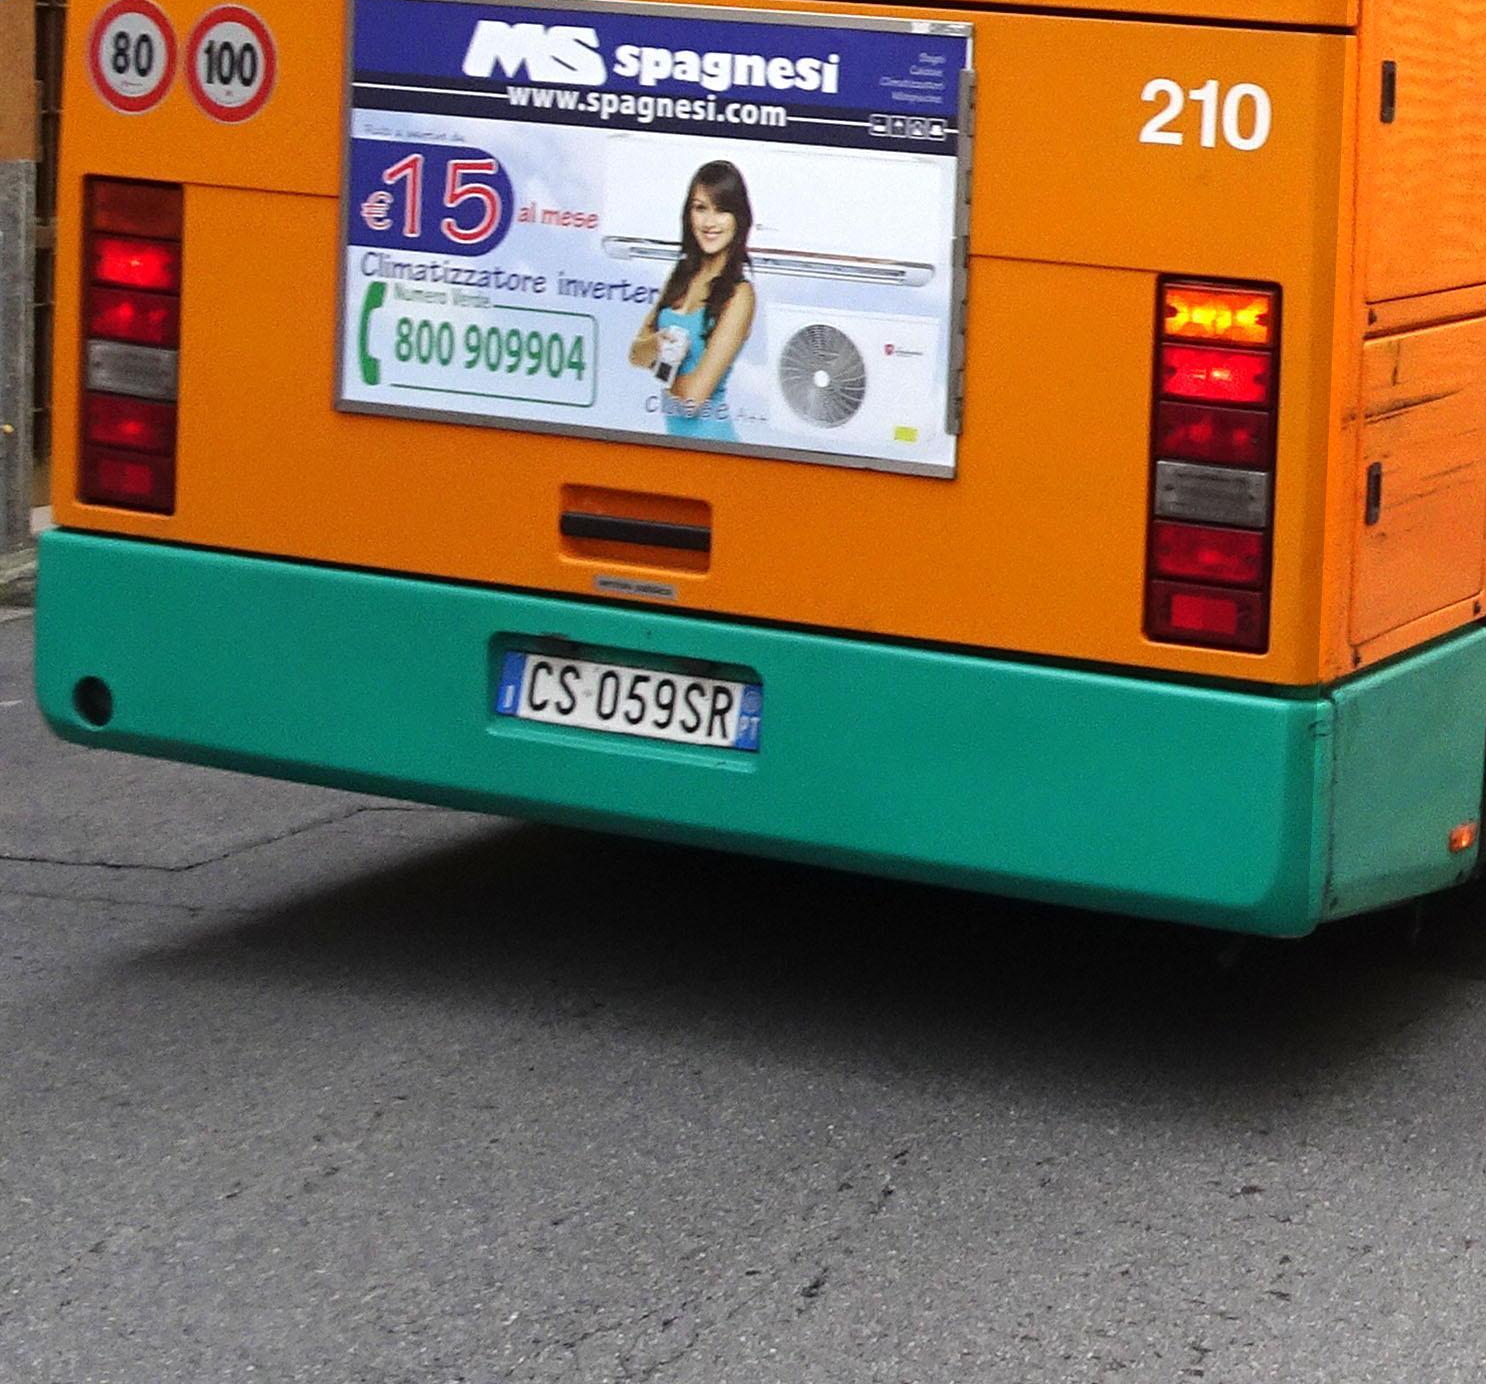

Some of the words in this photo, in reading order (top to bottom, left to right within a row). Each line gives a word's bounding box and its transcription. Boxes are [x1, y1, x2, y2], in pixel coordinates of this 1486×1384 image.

[112, 30, 154, 77] 80
[204, 39, 258, 87] 100
[461, 19, 608, 87] MS
[613, 44, 841, 95] spagnesi
[506, 84, 788, 128] www.spagnesi.com
[1138, 77, 1273, 152] 210
[516, 200, 537, 224] al
[541, 208, 600, 230] mese
[360, 250, 548, 295] Climatizzatore
[557, 268, 661, 305] inverter
[394, 316, 455, 367] 800
[463, 324, 587, 382] 909904
[528, 660, 582, 715] CS
[595, 670, 735, 740] 059SR
